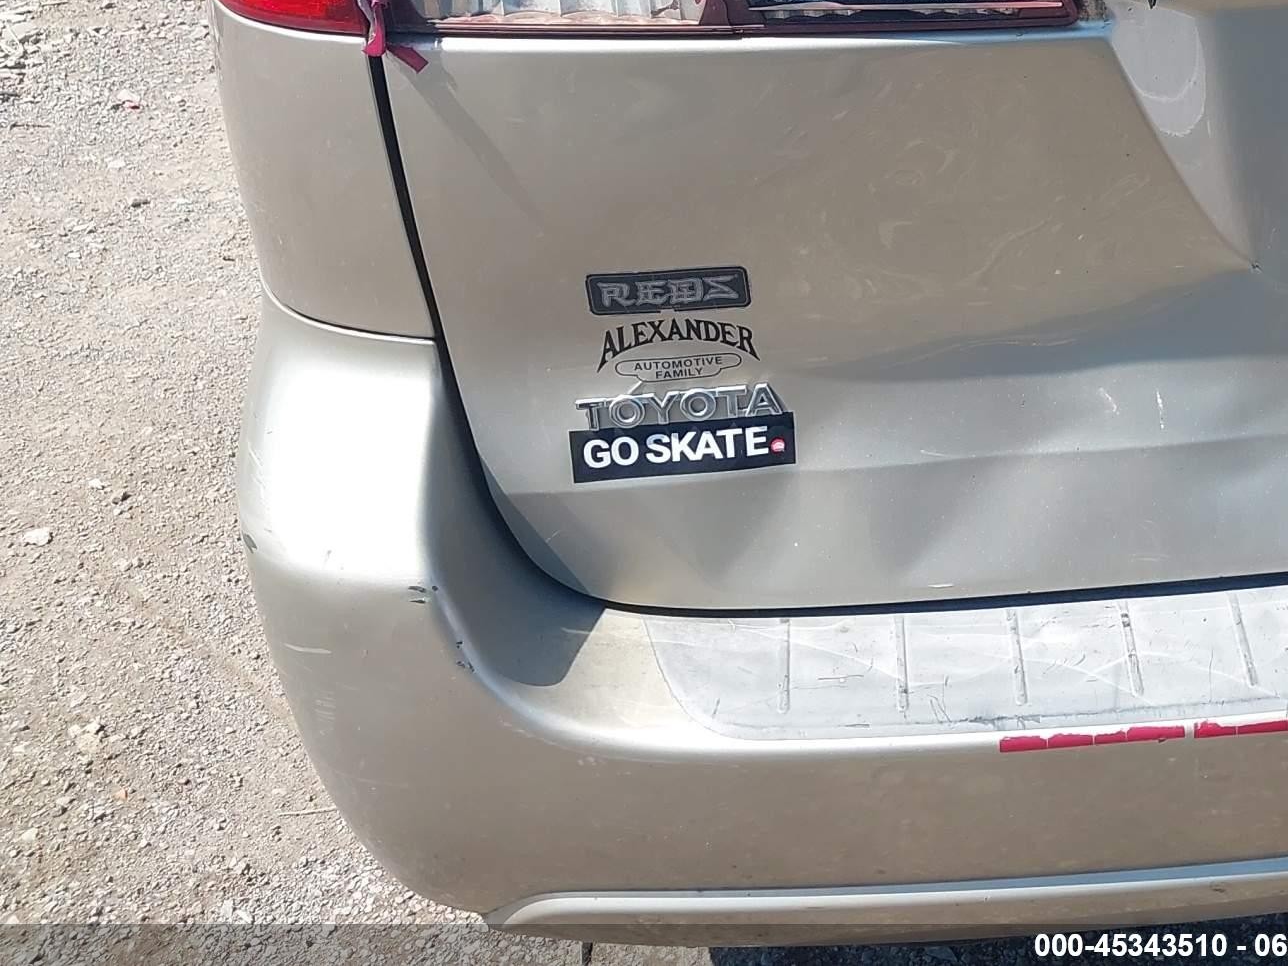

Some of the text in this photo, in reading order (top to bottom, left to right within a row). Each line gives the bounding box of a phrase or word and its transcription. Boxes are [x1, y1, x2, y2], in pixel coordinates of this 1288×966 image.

[597, 318, 761, 373] ALEXANDER
[634, 356, 723, 371] AUTOMOTIVE
[655, 367, 703, 379] FAMILY
[575, 382, 783, 431] TOYOTA
[583, 437, 640, 469] GO
